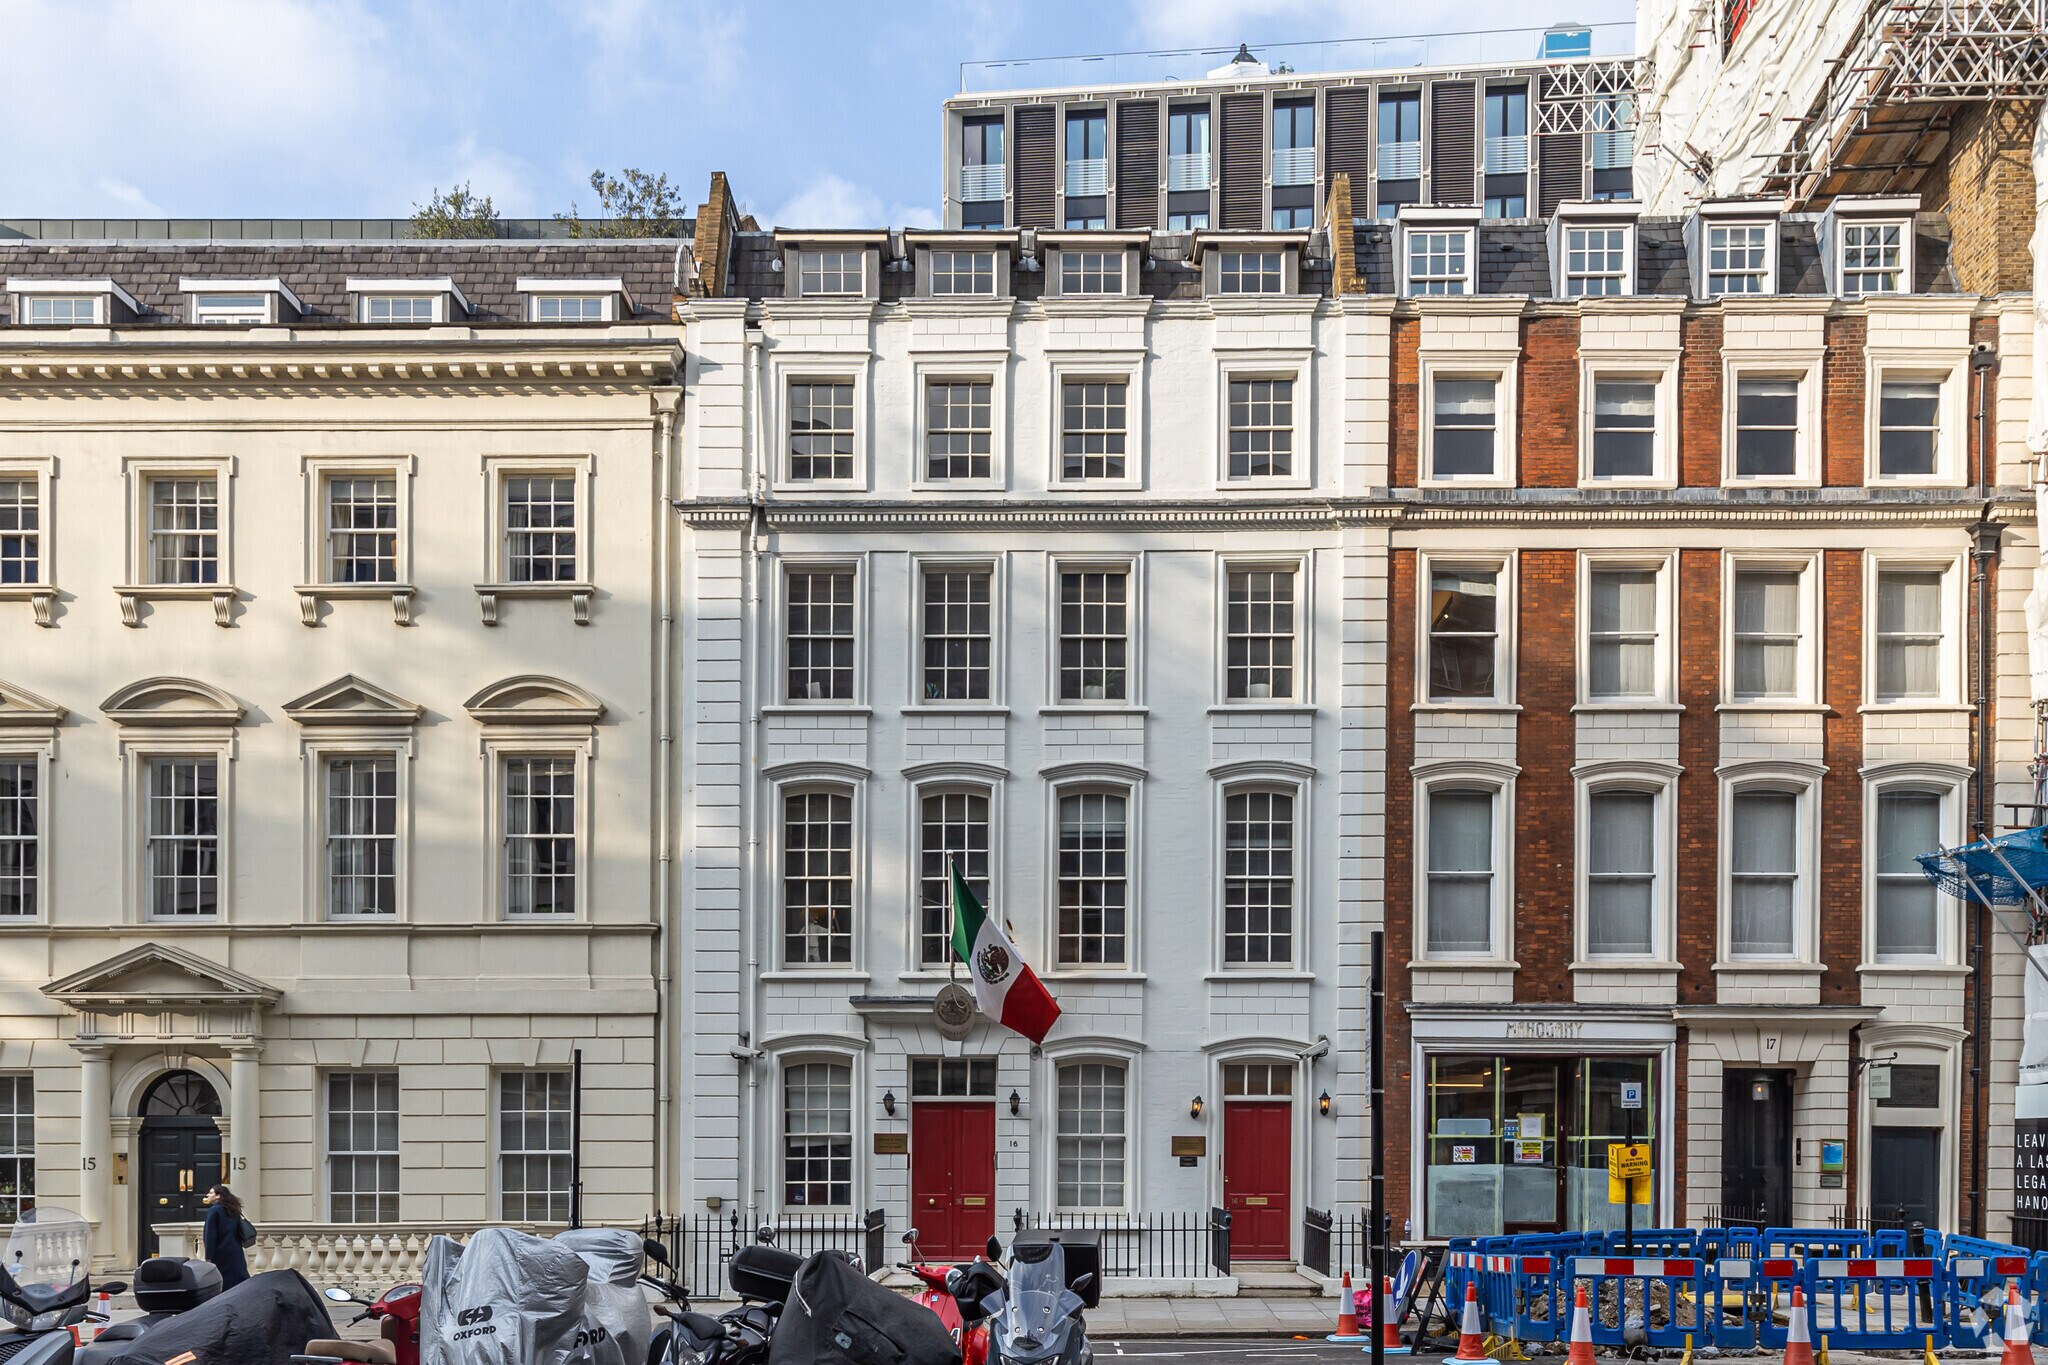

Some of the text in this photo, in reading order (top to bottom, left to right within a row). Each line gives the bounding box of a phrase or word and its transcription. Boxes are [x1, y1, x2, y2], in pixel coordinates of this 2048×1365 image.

[1505, 1021, 1584, 1039] MAHOGANY
[1766, 1038, 1777, 1050] 17
[1009, 1140, 1018, 1148] 16
[2017, 1133, 2048, 1148] LEAV
[82, 1157, 96, 1171] 15
[232, 1157, 246, 1171] 15
[1620, 1160, 1648, 1168] WARNING
[2016, 1154, 2023, 1168] A
[2016, 1175, 2047, 1189] LEGA
[2016, 1195, 2048, 1210] HANO
[453, 1325, 497, 1341] OXFORD
